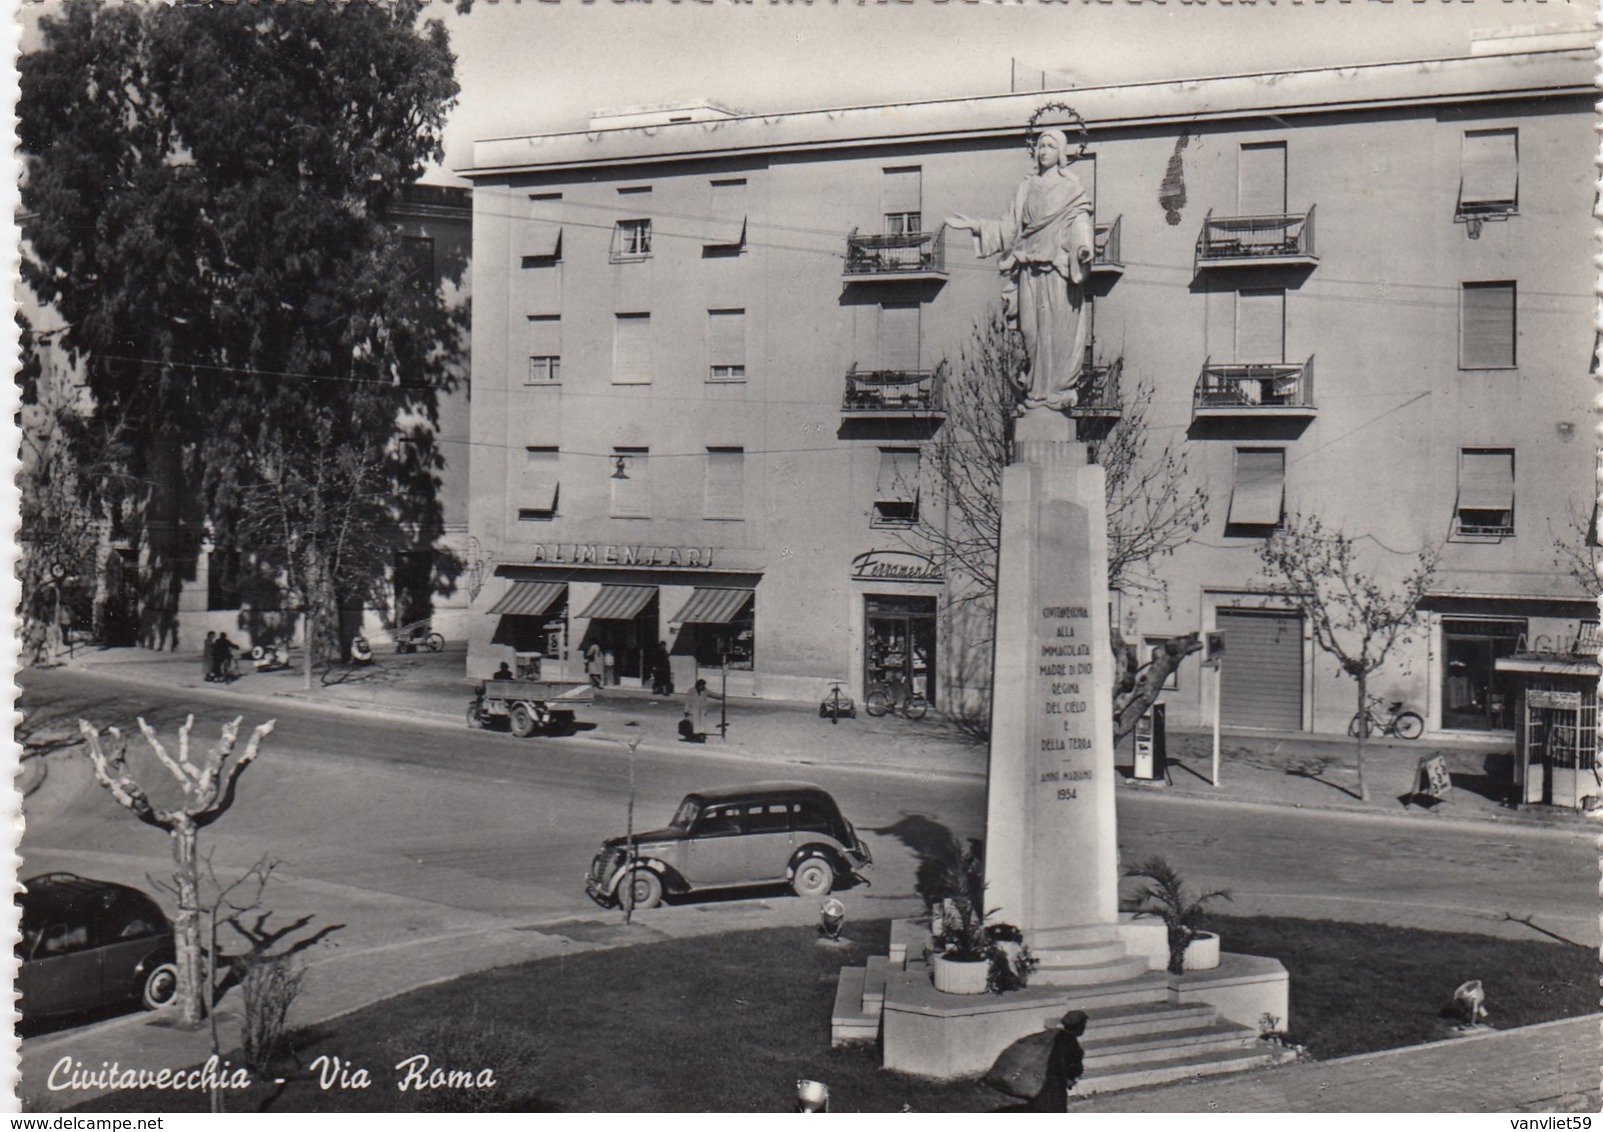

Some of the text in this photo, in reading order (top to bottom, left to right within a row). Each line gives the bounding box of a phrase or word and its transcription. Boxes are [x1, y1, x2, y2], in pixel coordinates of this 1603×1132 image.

[533, 542, 714, 568] ALIMENTARI
[1042, 606, 1089, 618] CIVITAVECCHIA
[1056, 625, 1075, 637] ALLA
[1041, 644, 1090, 657] IMMACOLATA
[1039, 663, 1067, 676] MADRE
[1078, 662, 1093, 675] DIO
[1052, 682, 1080, 695] REGINA
[1046, 700, 1087, 714] DEL CIELO
[1064, 720, 1070, 731] E
[1041, 737, 1092, 751] DELLA TERRA
[1041, 769, 1092, 782] ANNO MARIANO
[1057, 788, 1077, 800] 1954
